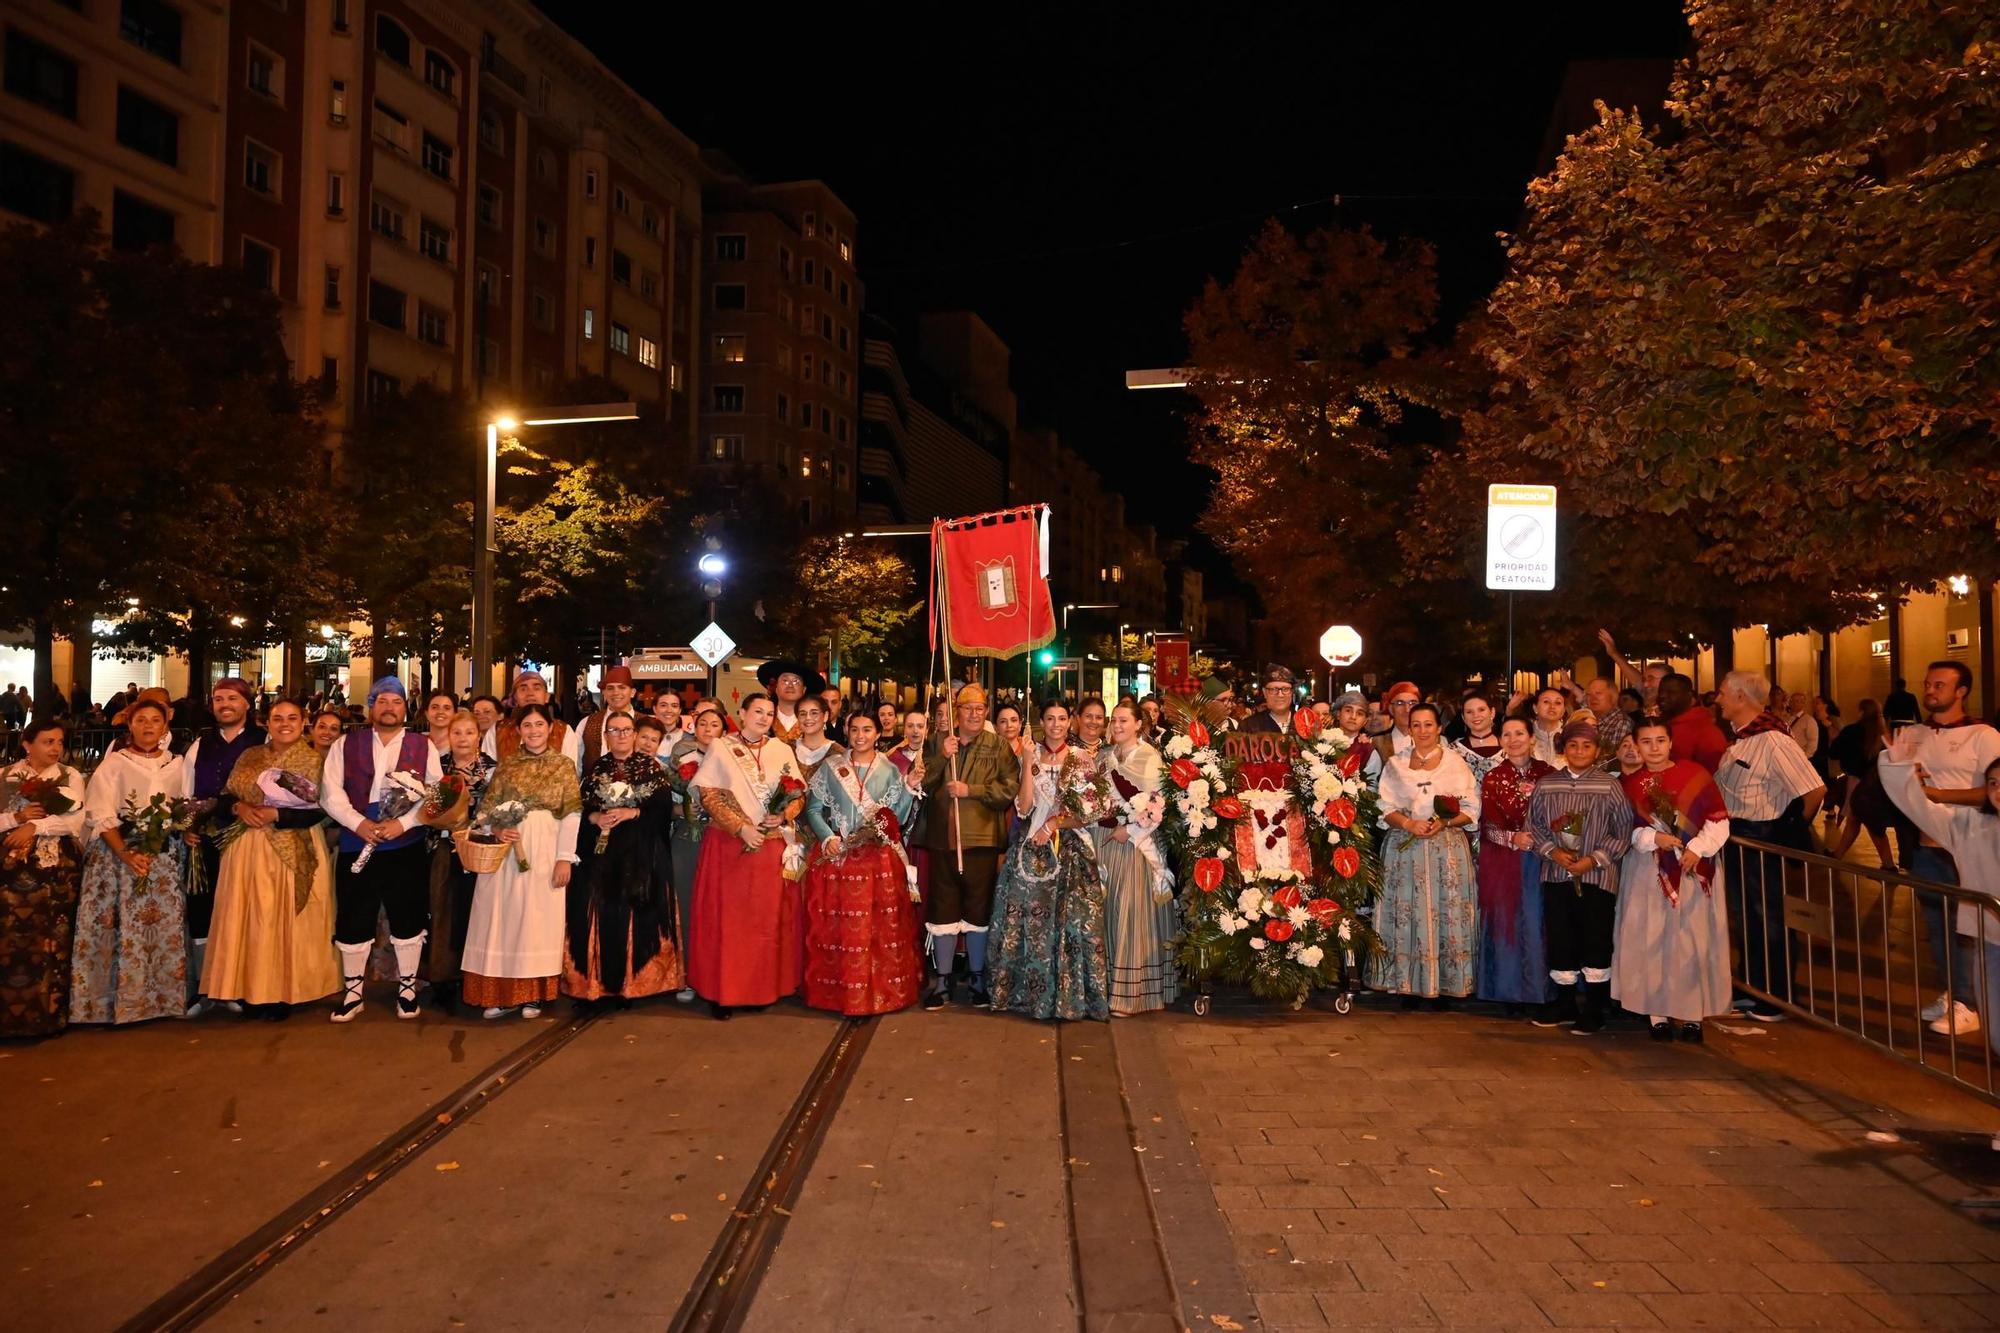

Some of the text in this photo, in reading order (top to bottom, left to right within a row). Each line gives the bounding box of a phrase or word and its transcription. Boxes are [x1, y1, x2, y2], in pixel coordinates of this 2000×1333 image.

[1494, 563, 1549, 571] PRIORIDAD
[1495, 575, 1547, 583] PEATONAL
[703, 637, 723, 652] 30
[638, 664, 704, 673] AMBULANCIA
